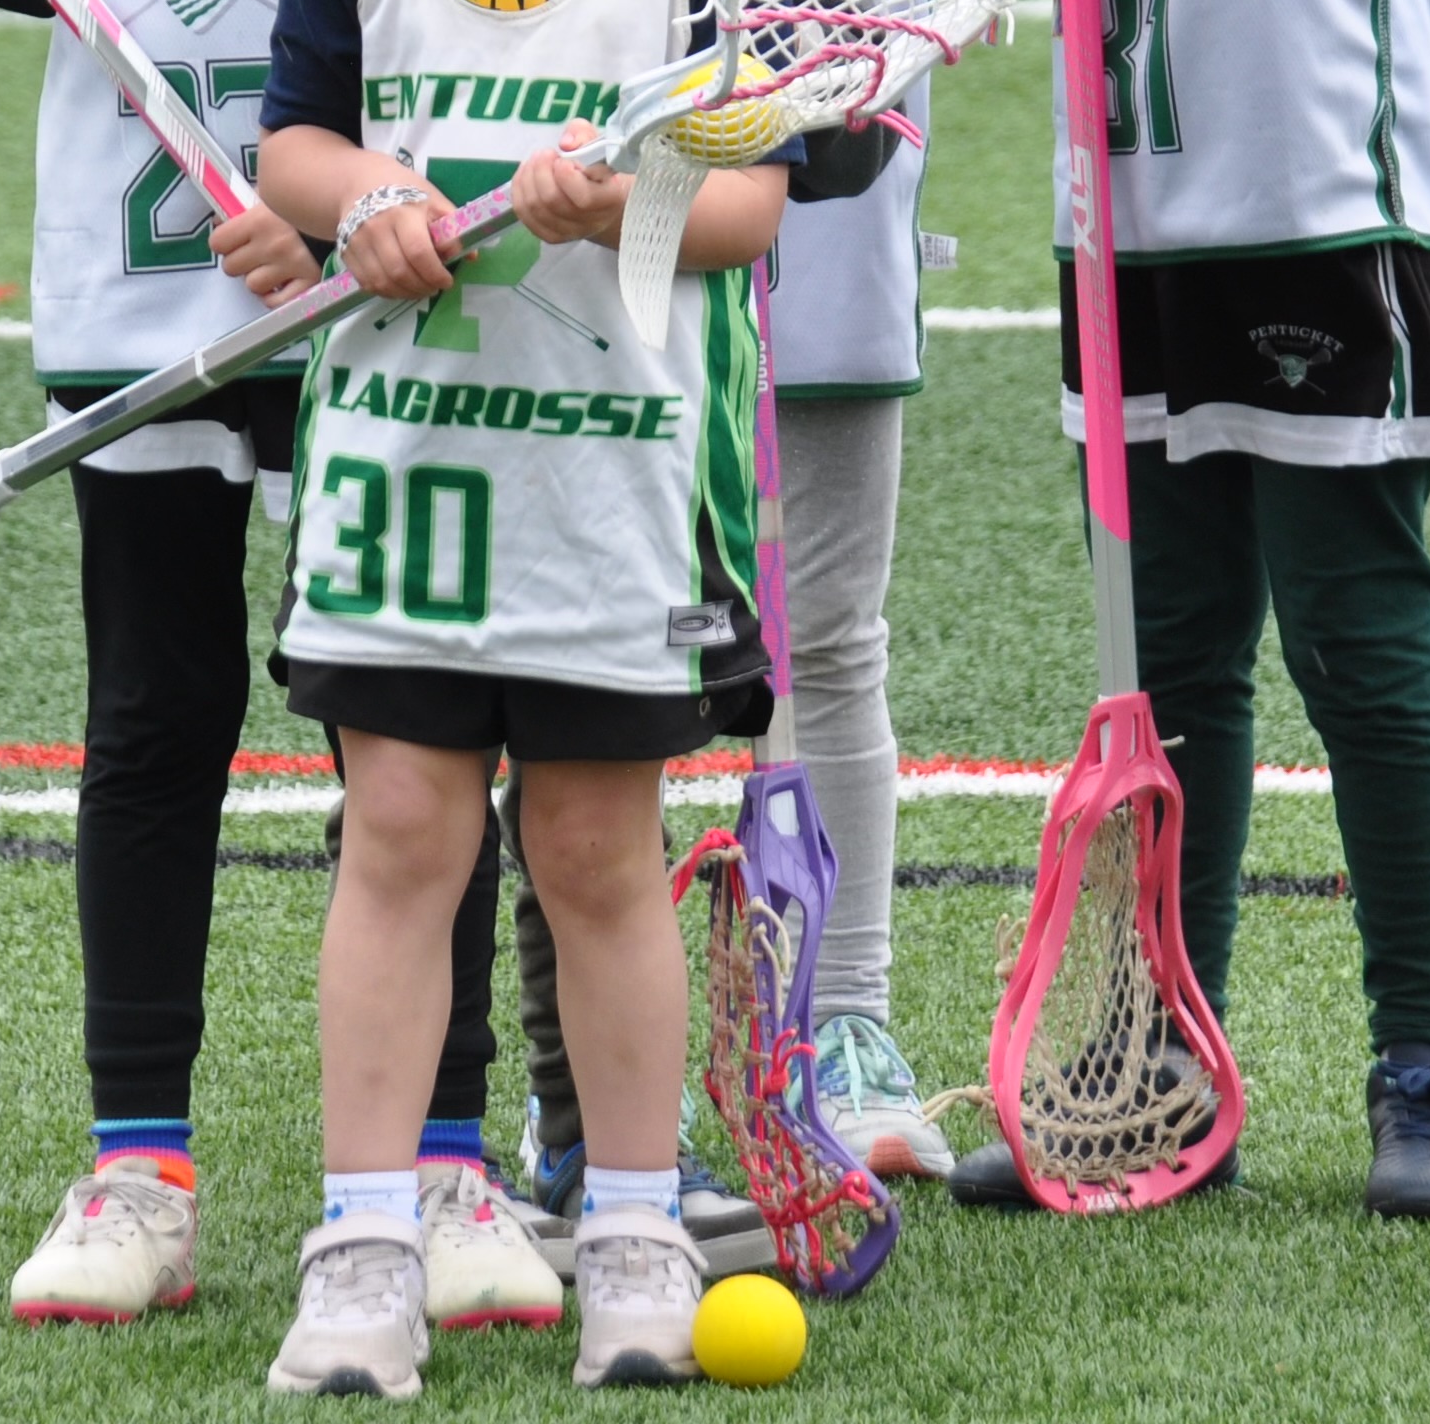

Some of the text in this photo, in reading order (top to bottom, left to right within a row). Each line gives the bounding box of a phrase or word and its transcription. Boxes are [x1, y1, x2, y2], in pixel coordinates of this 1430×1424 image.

[1072, 142, 1097, 258] STX
[1248, 324, 1345, 353] PENTUCKET
[326, 364, 684, 440] LACROSSE
[305, 451, 494, 626] 30
